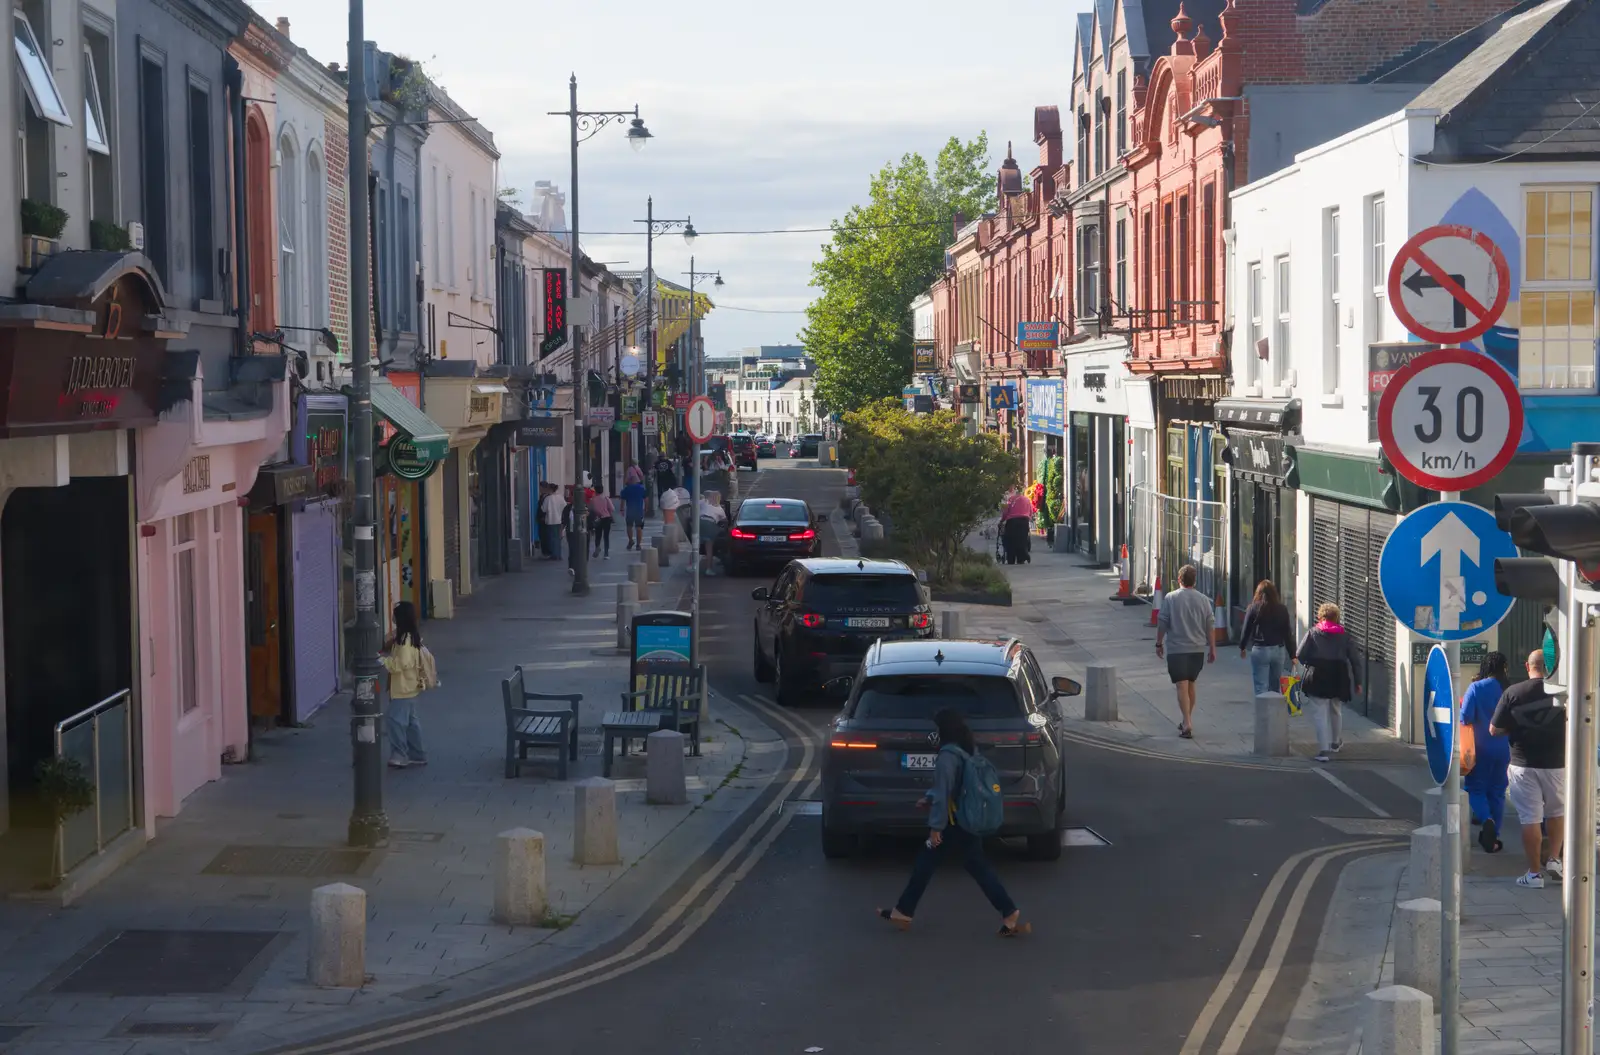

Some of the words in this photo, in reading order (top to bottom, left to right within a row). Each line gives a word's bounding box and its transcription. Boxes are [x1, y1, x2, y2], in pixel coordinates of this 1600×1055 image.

[1024, 323, 1054, 331] SMART
[1025, 331, 1051, 339] SHOP
[917, 355, 934, 363] BET
[1414, 386, 1484, 444] 30
[1421, 450, 1476, 471] km/h
